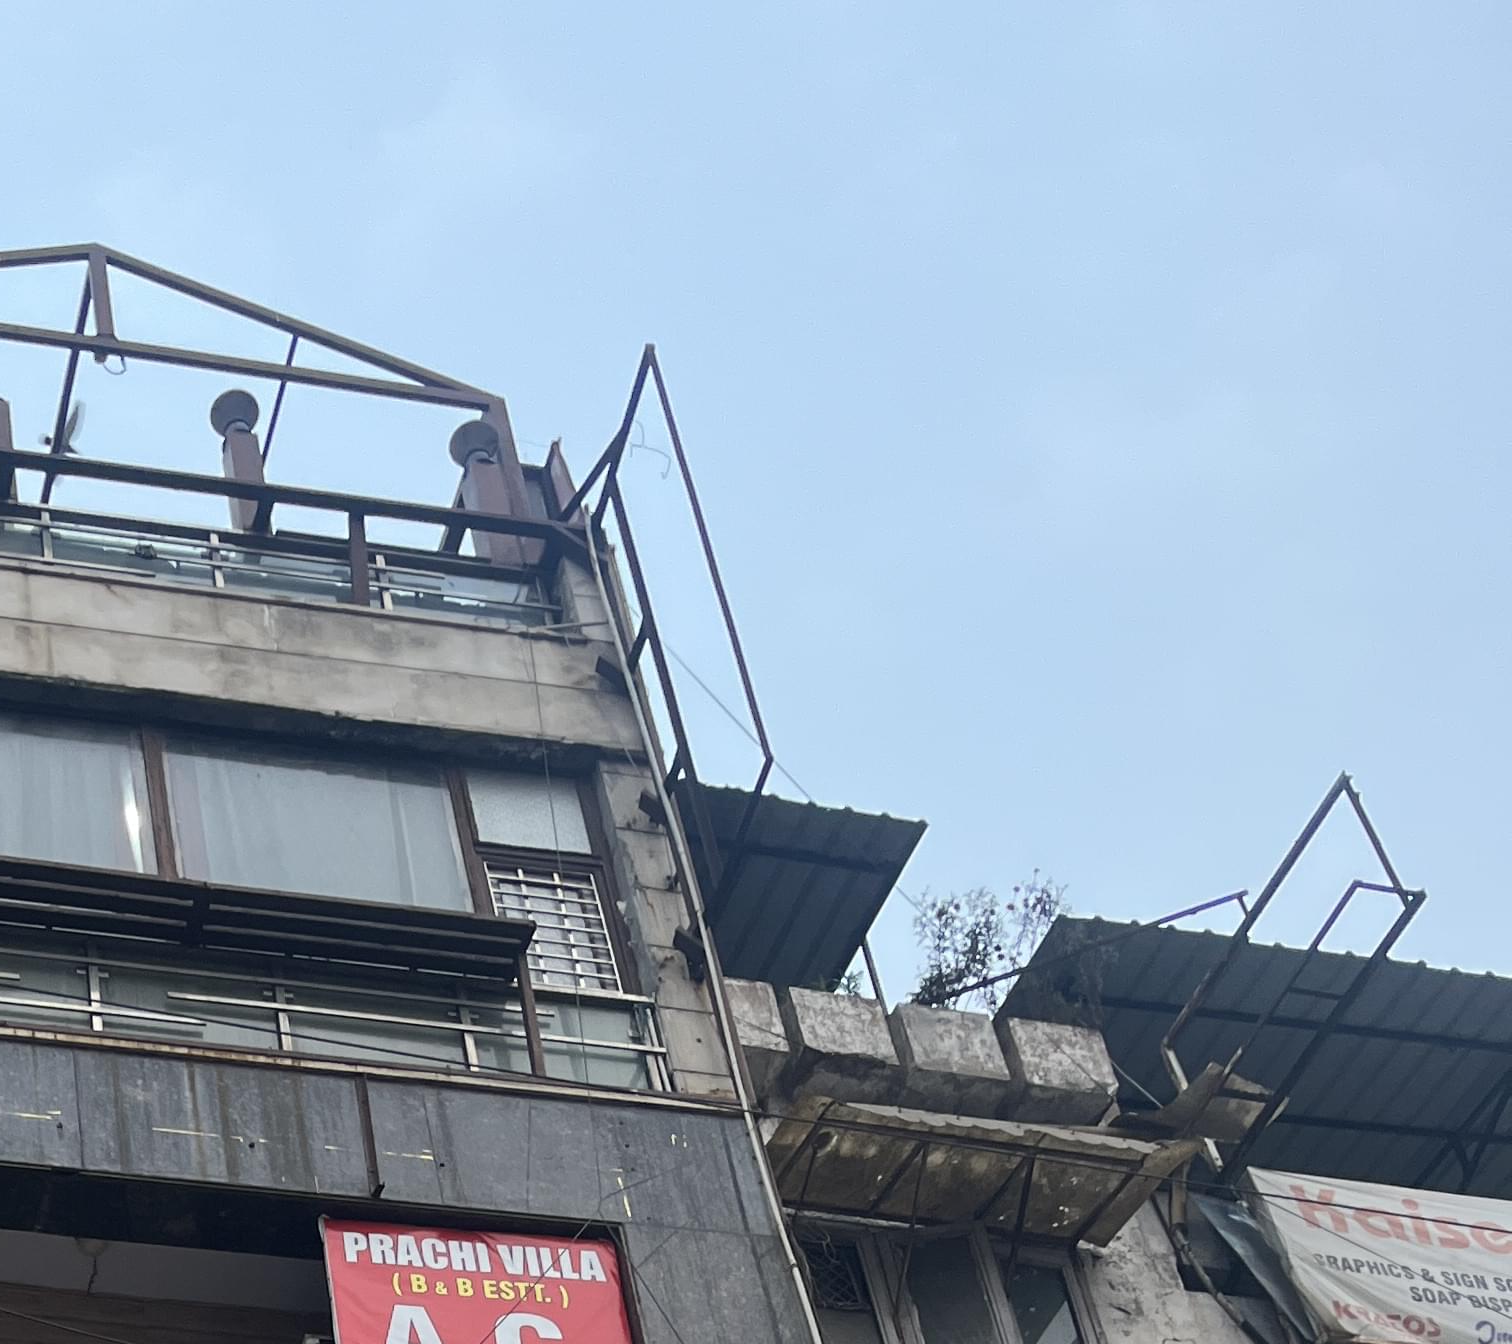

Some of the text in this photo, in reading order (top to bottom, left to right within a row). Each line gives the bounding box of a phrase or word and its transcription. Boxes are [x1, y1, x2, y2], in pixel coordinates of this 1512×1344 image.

[342, 1231, 608, 1283] PRACHI VILLA
[1312, 1253, 1416, 1281] GRAPHICS
[1440, 1270, 1489, 1291] SIGN
[1409, 1286, 1460, 1306] SOAP
